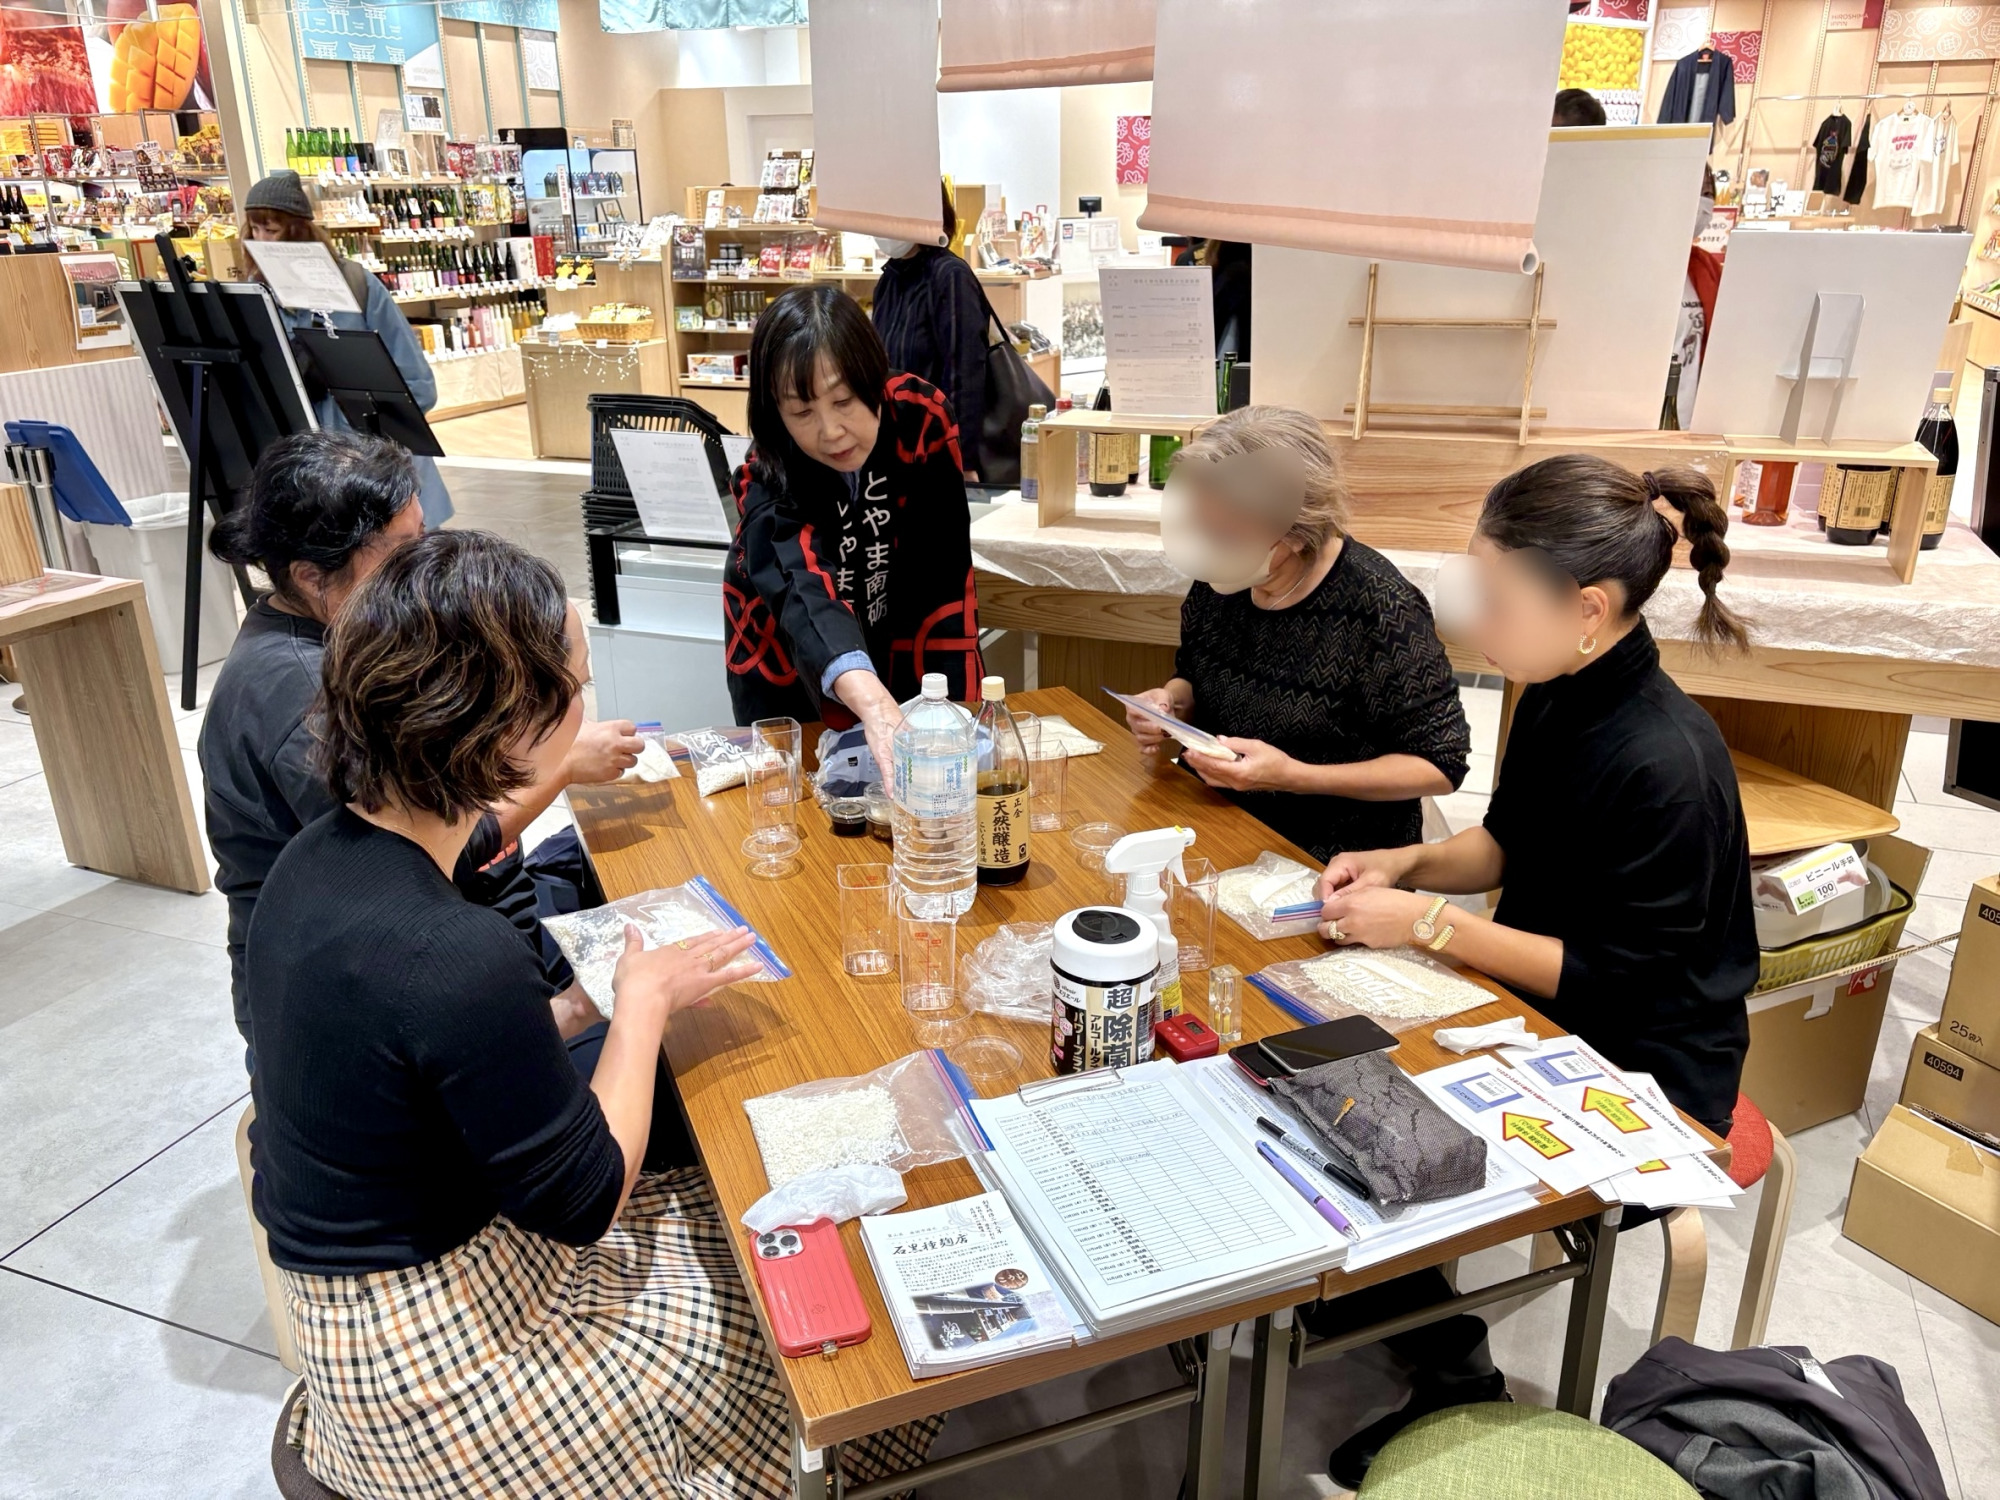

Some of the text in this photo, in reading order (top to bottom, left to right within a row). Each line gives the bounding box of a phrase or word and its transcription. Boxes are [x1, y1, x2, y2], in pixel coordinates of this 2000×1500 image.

[862, 470, 891, 627] とやま南砺
[1013, 798, 1023, 818] 正金
[992, 799, 1011, 864] 天然醸造
[1806, 855, 1855, 882] ビニール手袋
[1817, 883, 1834, 896] 100
[1059, 989, 1081, 1004] エリエール
[1107, 989, 1133, 1010] 超
[1950, 1020, 1984, 1047] 25袋入
[1926, 1055, 1962, 1079] 40594
